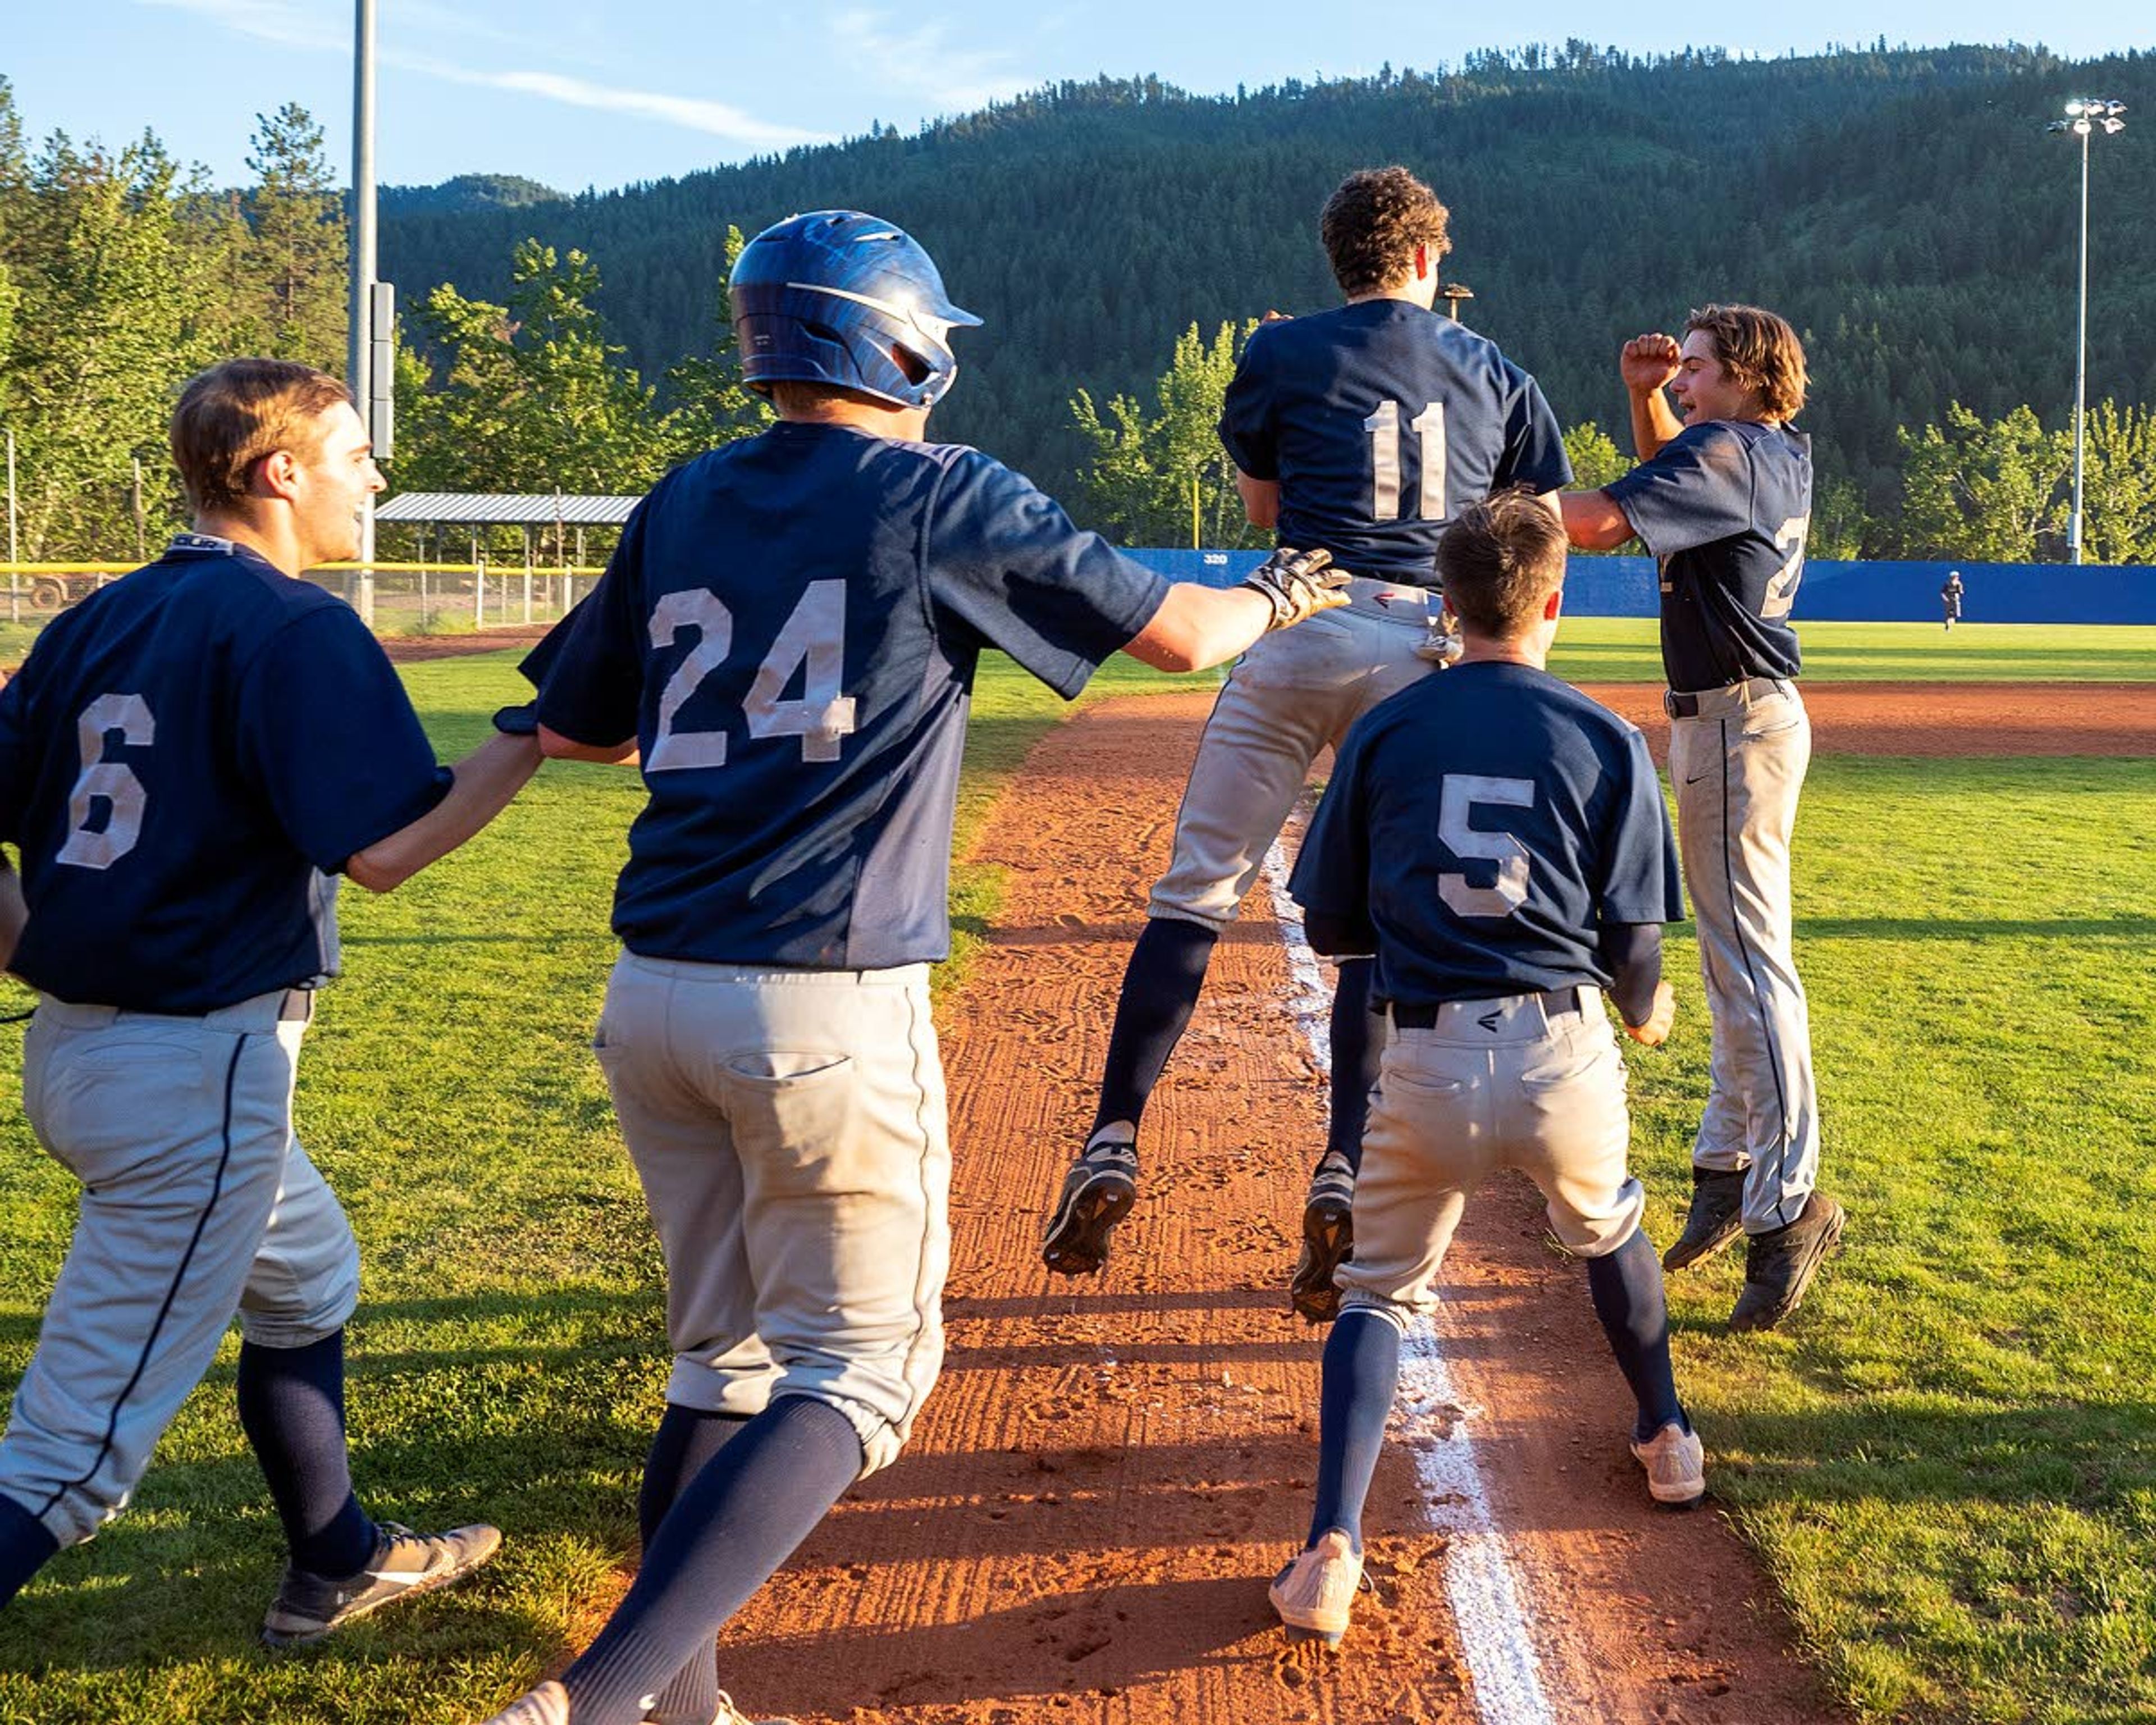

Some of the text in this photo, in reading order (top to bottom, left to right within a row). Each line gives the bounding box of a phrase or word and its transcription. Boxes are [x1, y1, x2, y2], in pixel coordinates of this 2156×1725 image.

[1364, 400, 1447, 521] 11
[1203, 554, 1228, 565] 320
[646, 578, 857, 772] 24
[56, 693, 156, 870] 6
[1438, 774, 1535, 918] 5
